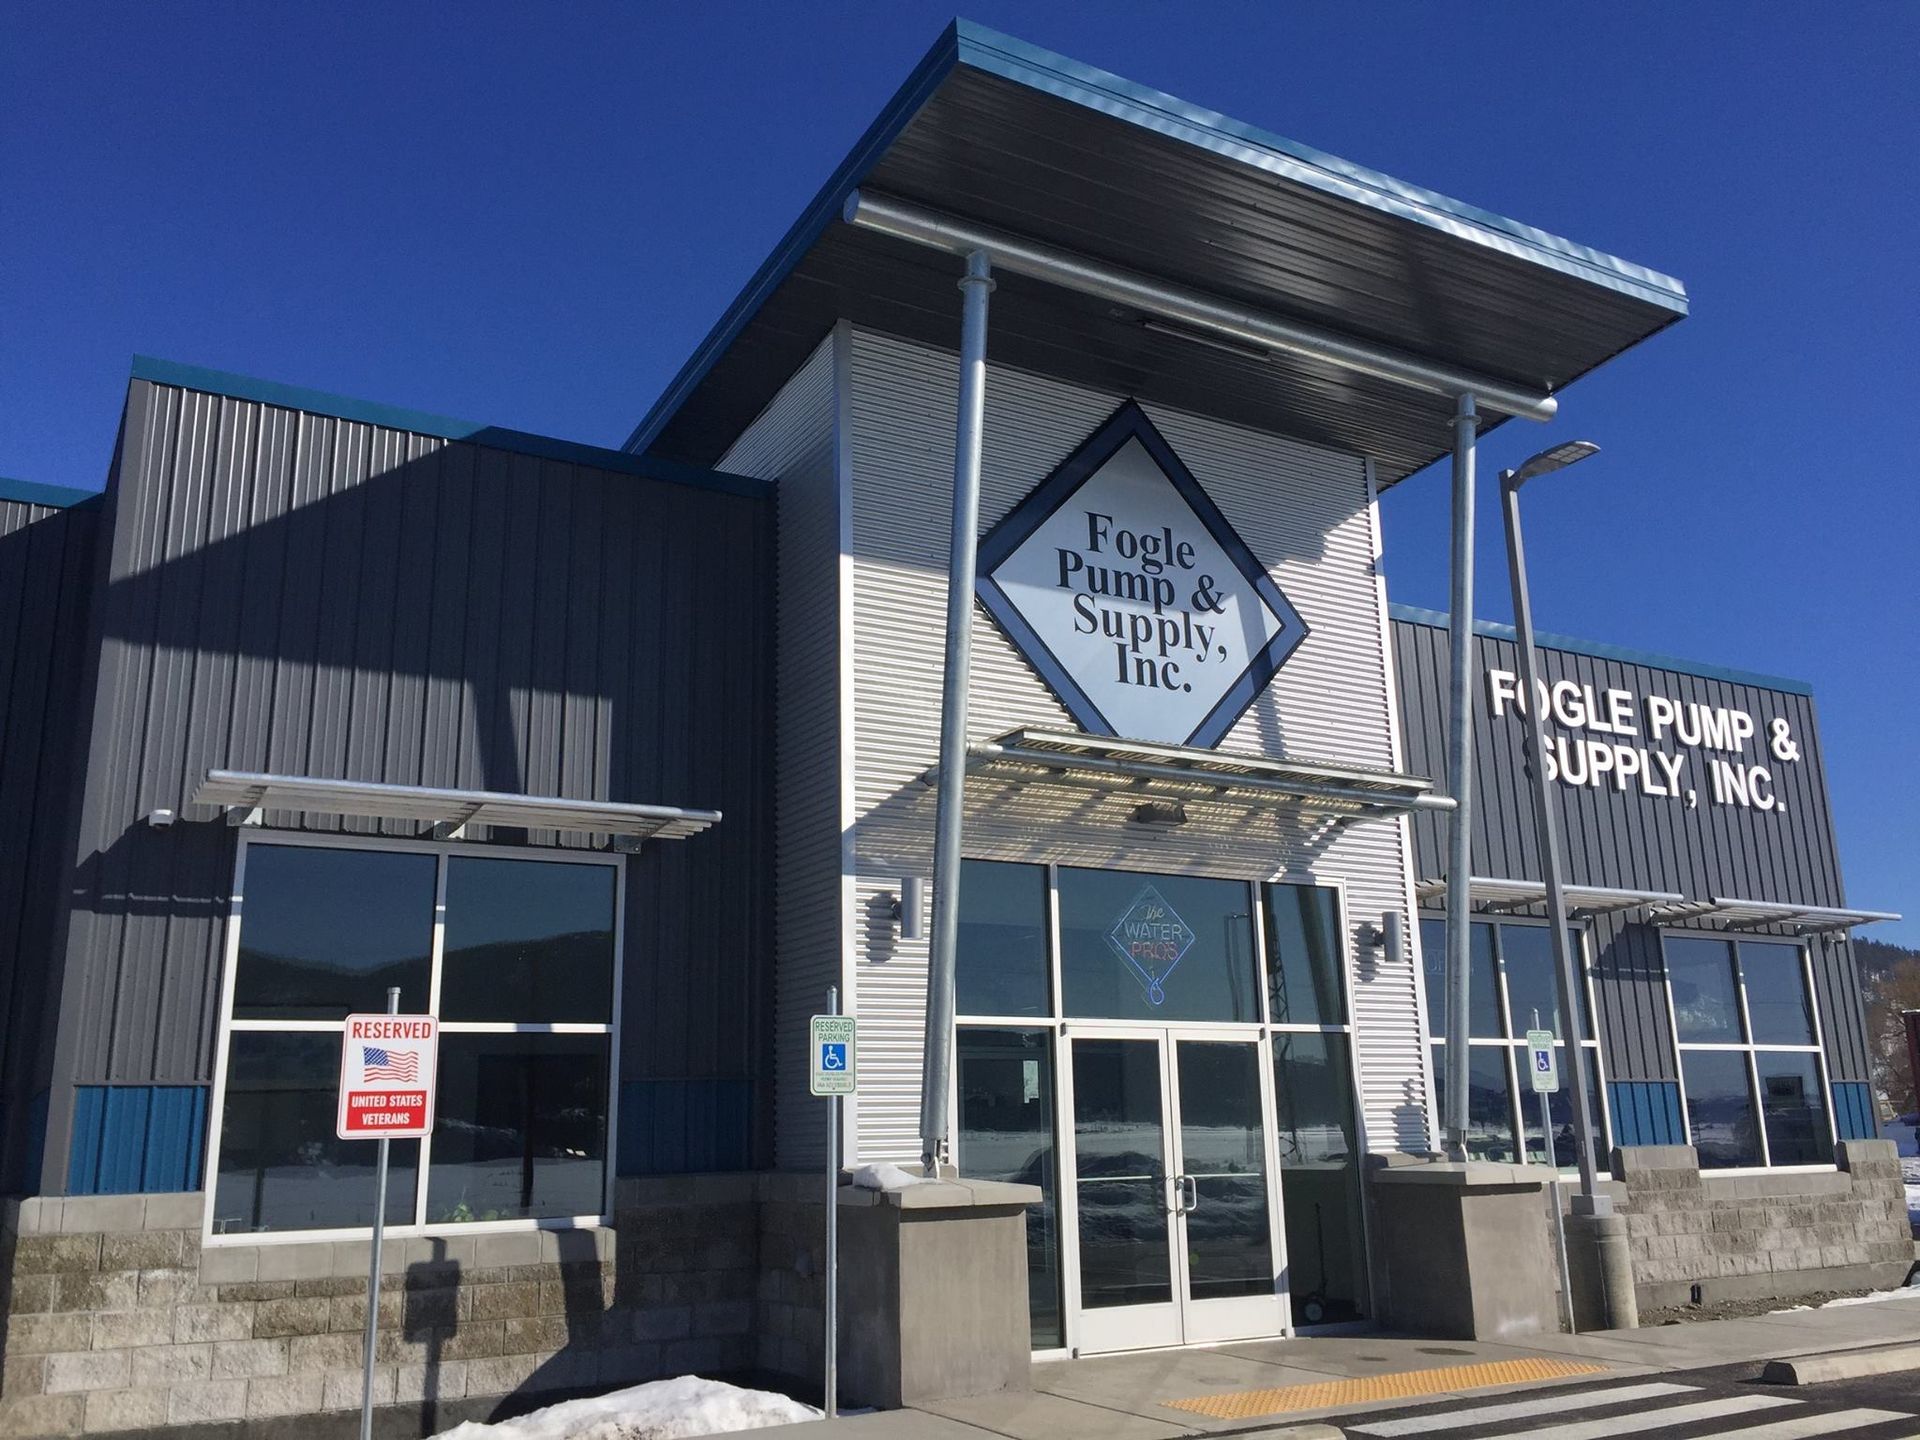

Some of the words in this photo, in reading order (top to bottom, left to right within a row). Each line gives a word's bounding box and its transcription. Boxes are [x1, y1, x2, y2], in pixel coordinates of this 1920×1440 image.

[1084, 511, 1195, 575] Fogle
[1055, 548, 1175, 615] Pump
[1191, 574, 1226, 614] &
[1073, 592, 1228, 664] Supply,
[1112, 641, 1193, 694] Inc.
[1489, 669, 1638, 737] FOGLE
[1649, 695, 1755, 753] PUMP
[1770, 718, 1801, 763] &
[1711, 759, 1786, 813] INC.
[1125, 922, 1182, 941] WATER
[1131, 941, 1178, 960] PROS
[352, 1021, 432, 1039] RESERVED
[815, 1021, 853, 1032] RESERVED
[818, 1033, 850, 1042] PARKING
[351, 1095, 387, 1108] UNITED
[389, 1094, 423, 1107] STATES
[361, 1112, 411, 1126] VETERANS
